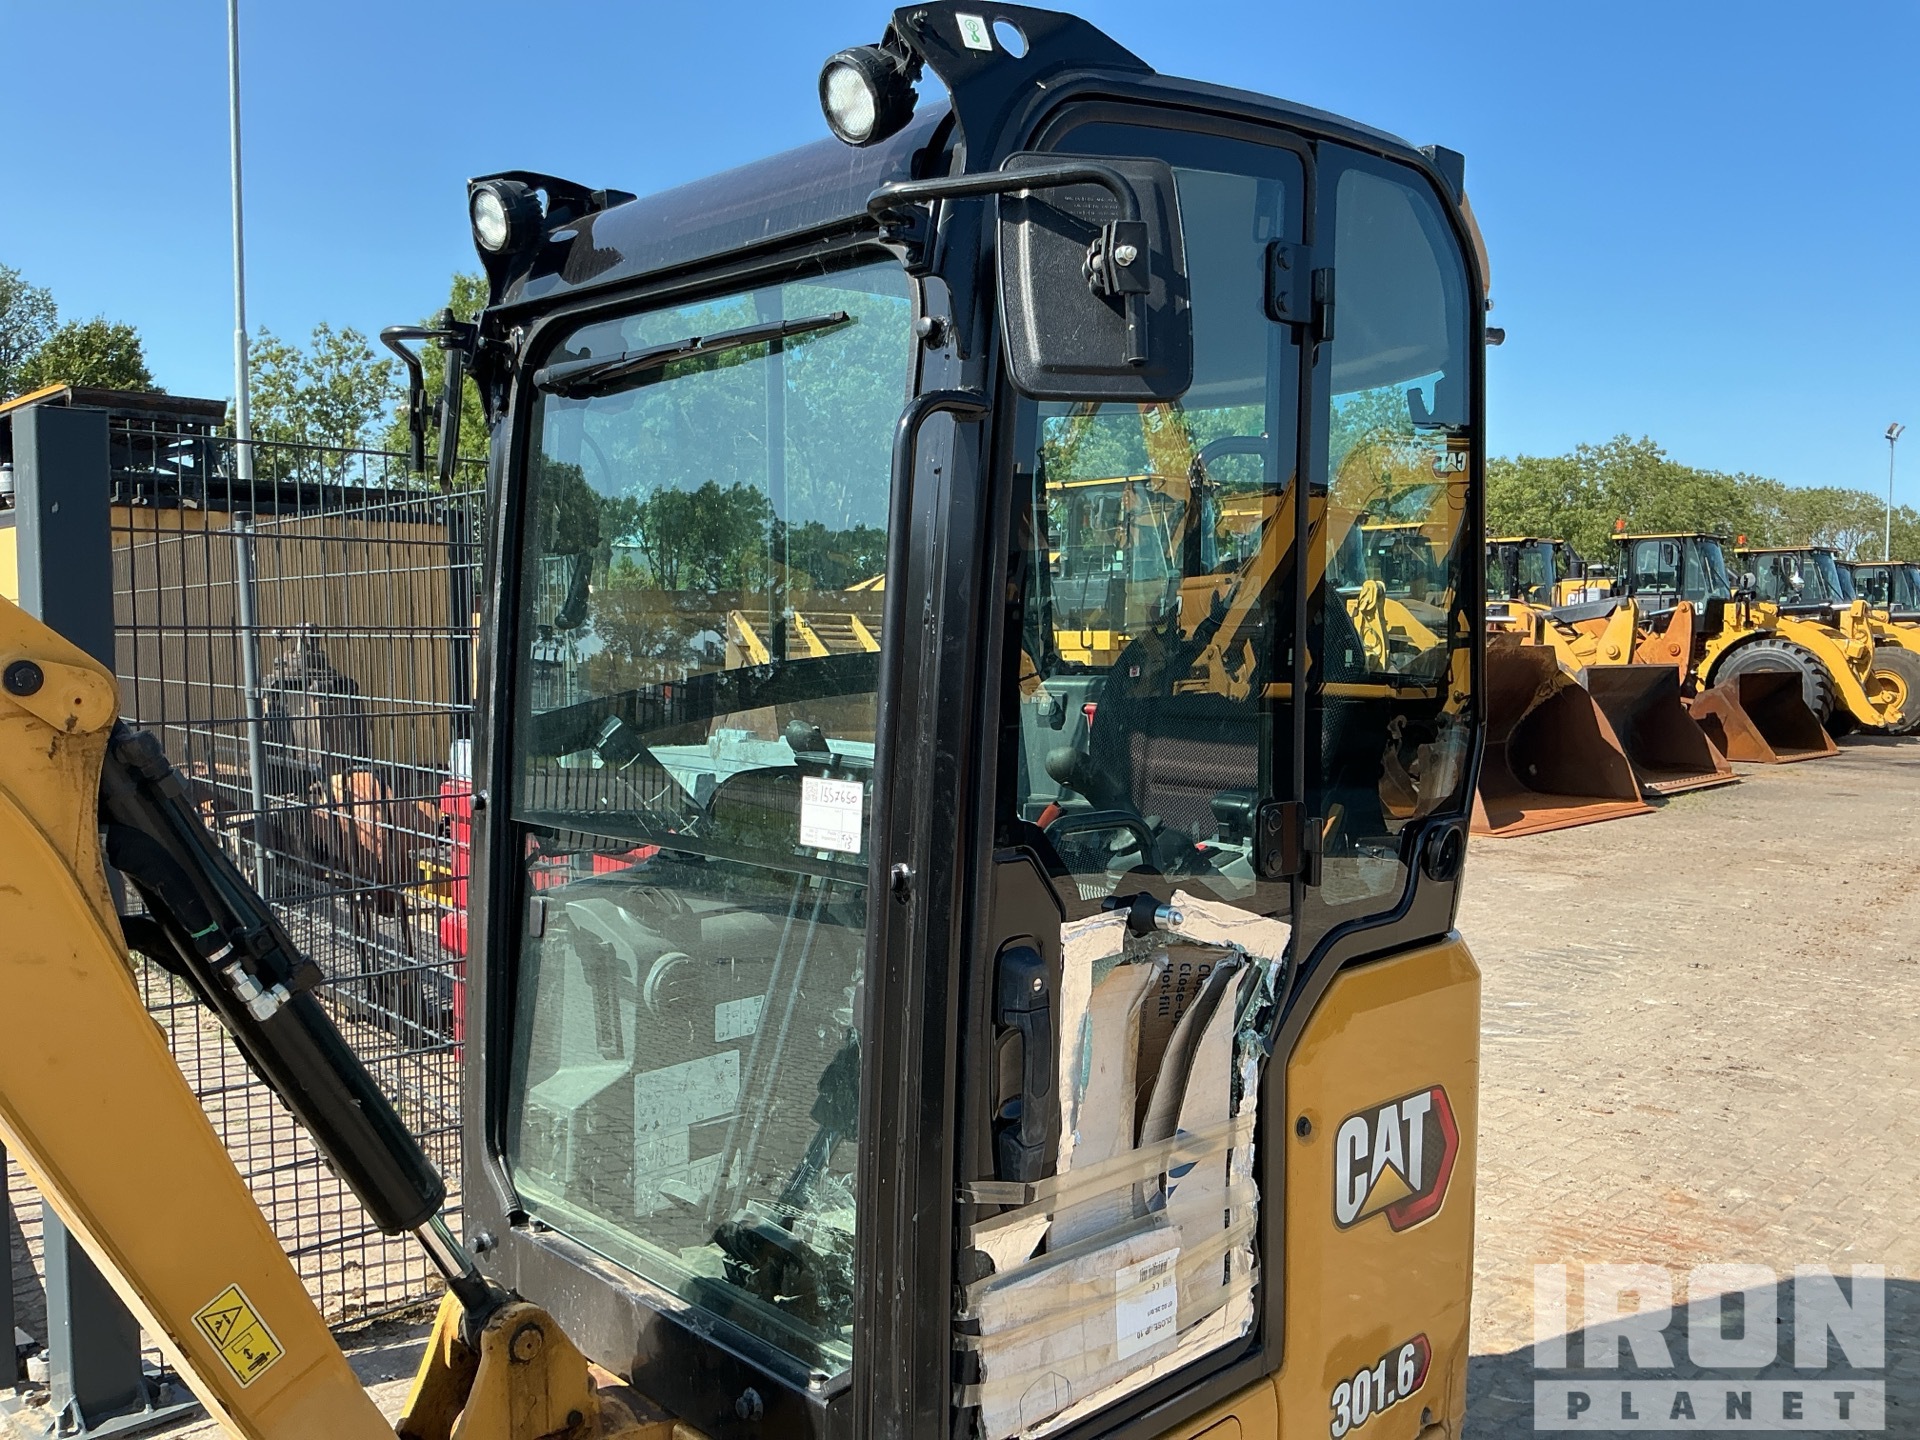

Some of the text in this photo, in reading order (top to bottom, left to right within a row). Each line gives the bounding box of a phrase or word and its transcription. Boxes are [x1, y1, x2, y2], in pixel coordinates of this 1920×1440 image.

[1158, 963, 1174, 1018] Hot-fill
[1336, 1091, 1431, 1224] CAT
[1331, 1343, 1415, 1438] 301.6
